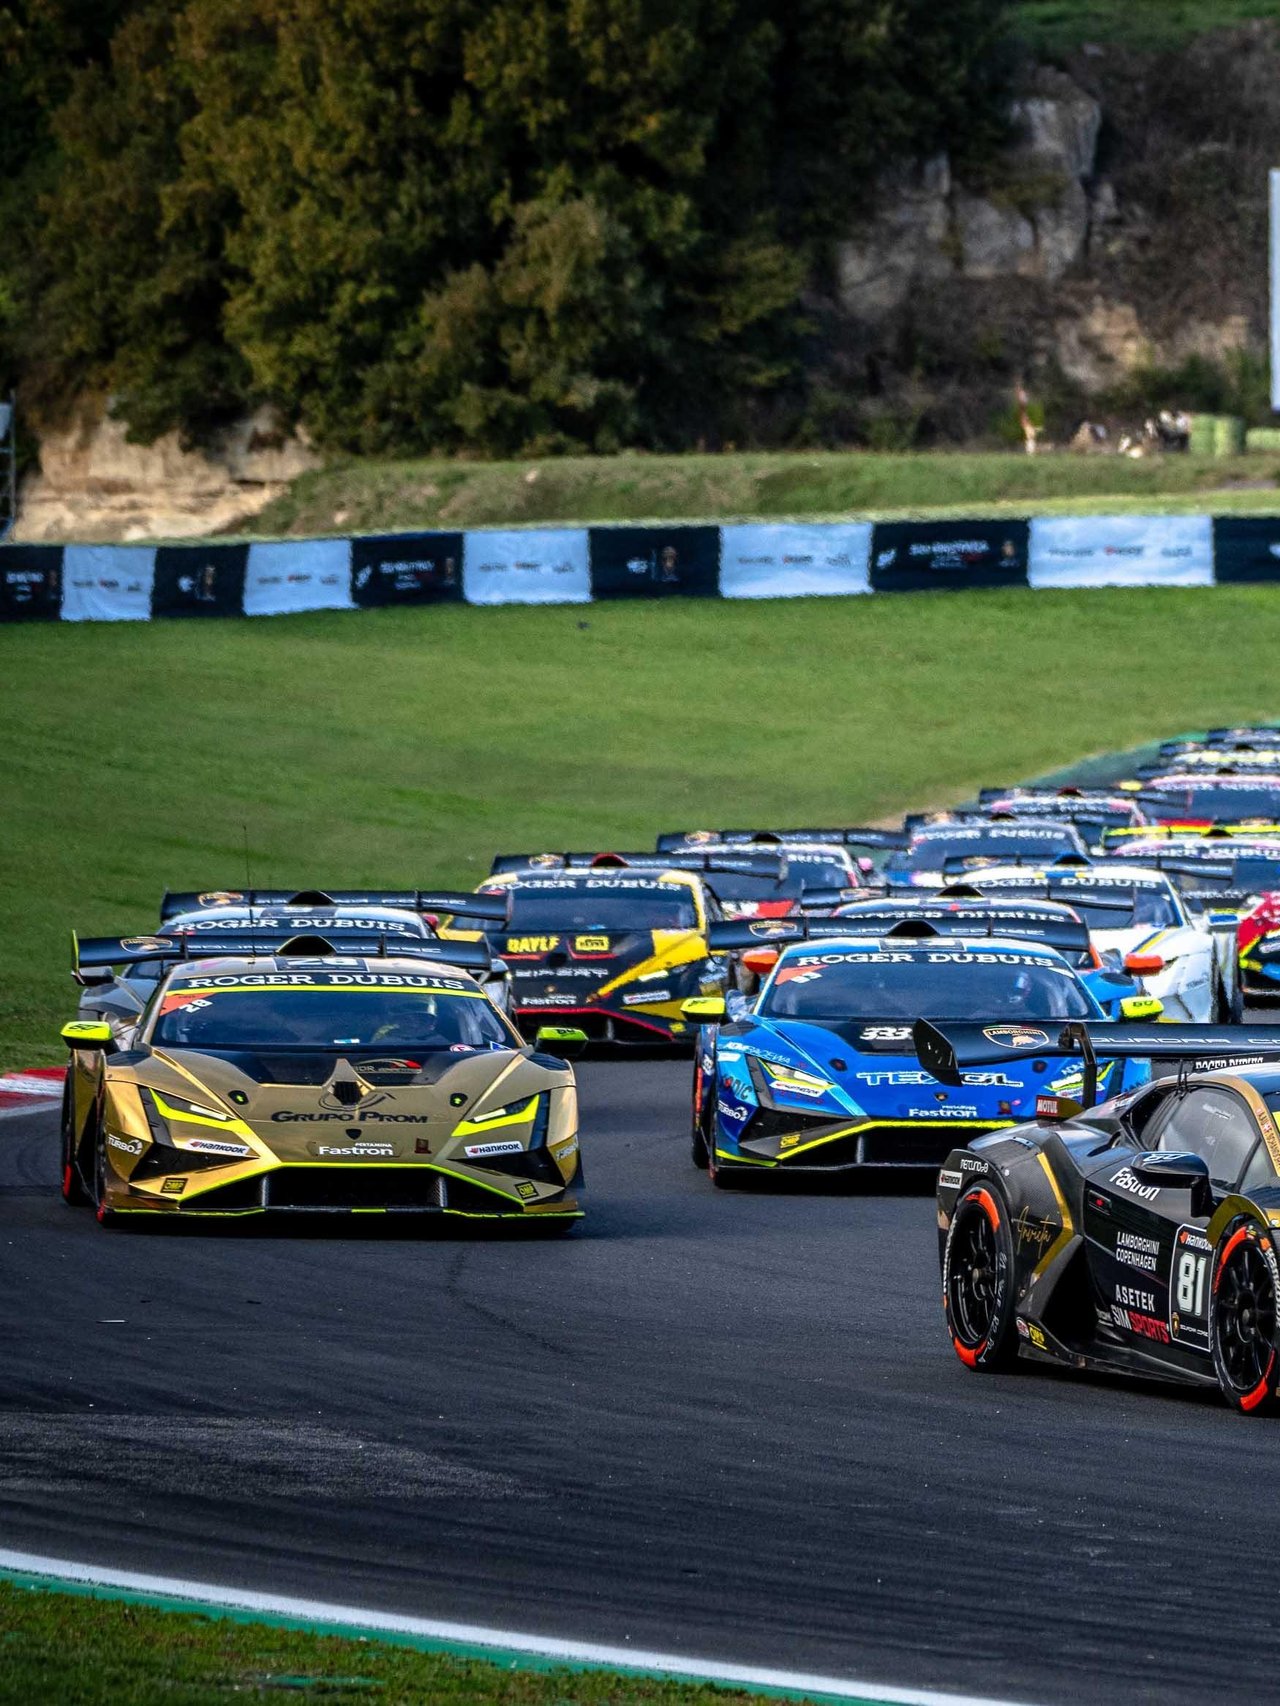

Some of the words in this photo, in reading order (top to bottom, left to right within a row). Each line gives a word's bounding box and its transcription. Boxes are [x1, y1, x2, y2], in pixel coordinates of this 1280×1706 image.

[175, 918, 277, 932] ROGER
[290, 918, 404, 931] DUBUIS
[797, 953, 914, 966] ROGER
[928, 953, 1054, 967] DUBUIS
[188, 974, 315, 989] ROGER
[329, 974, 465, 990] DUBUIS
[987, 1028, 1043, 1037] LAMBORGHINI
[909, 1108, 977, 1118] Fastron
[1037, 1099, 1058, 1113] MOTUL
[271, 1111, 354, 1123] GRUPO
[359, 1111, 428, 1123] PROM
[108, 1136, 134, 1152] TURBO
[319, 1145, 393, 1156] Fastron
[1117, 1231, 1160, 1255] LAMBORGHINI
[1116, 1248, 1157, 1271] COPENHAGEN
[1177, 1252, 1207, 1317] 81
[1115, 1284, 1156, 1313] ASETEK
